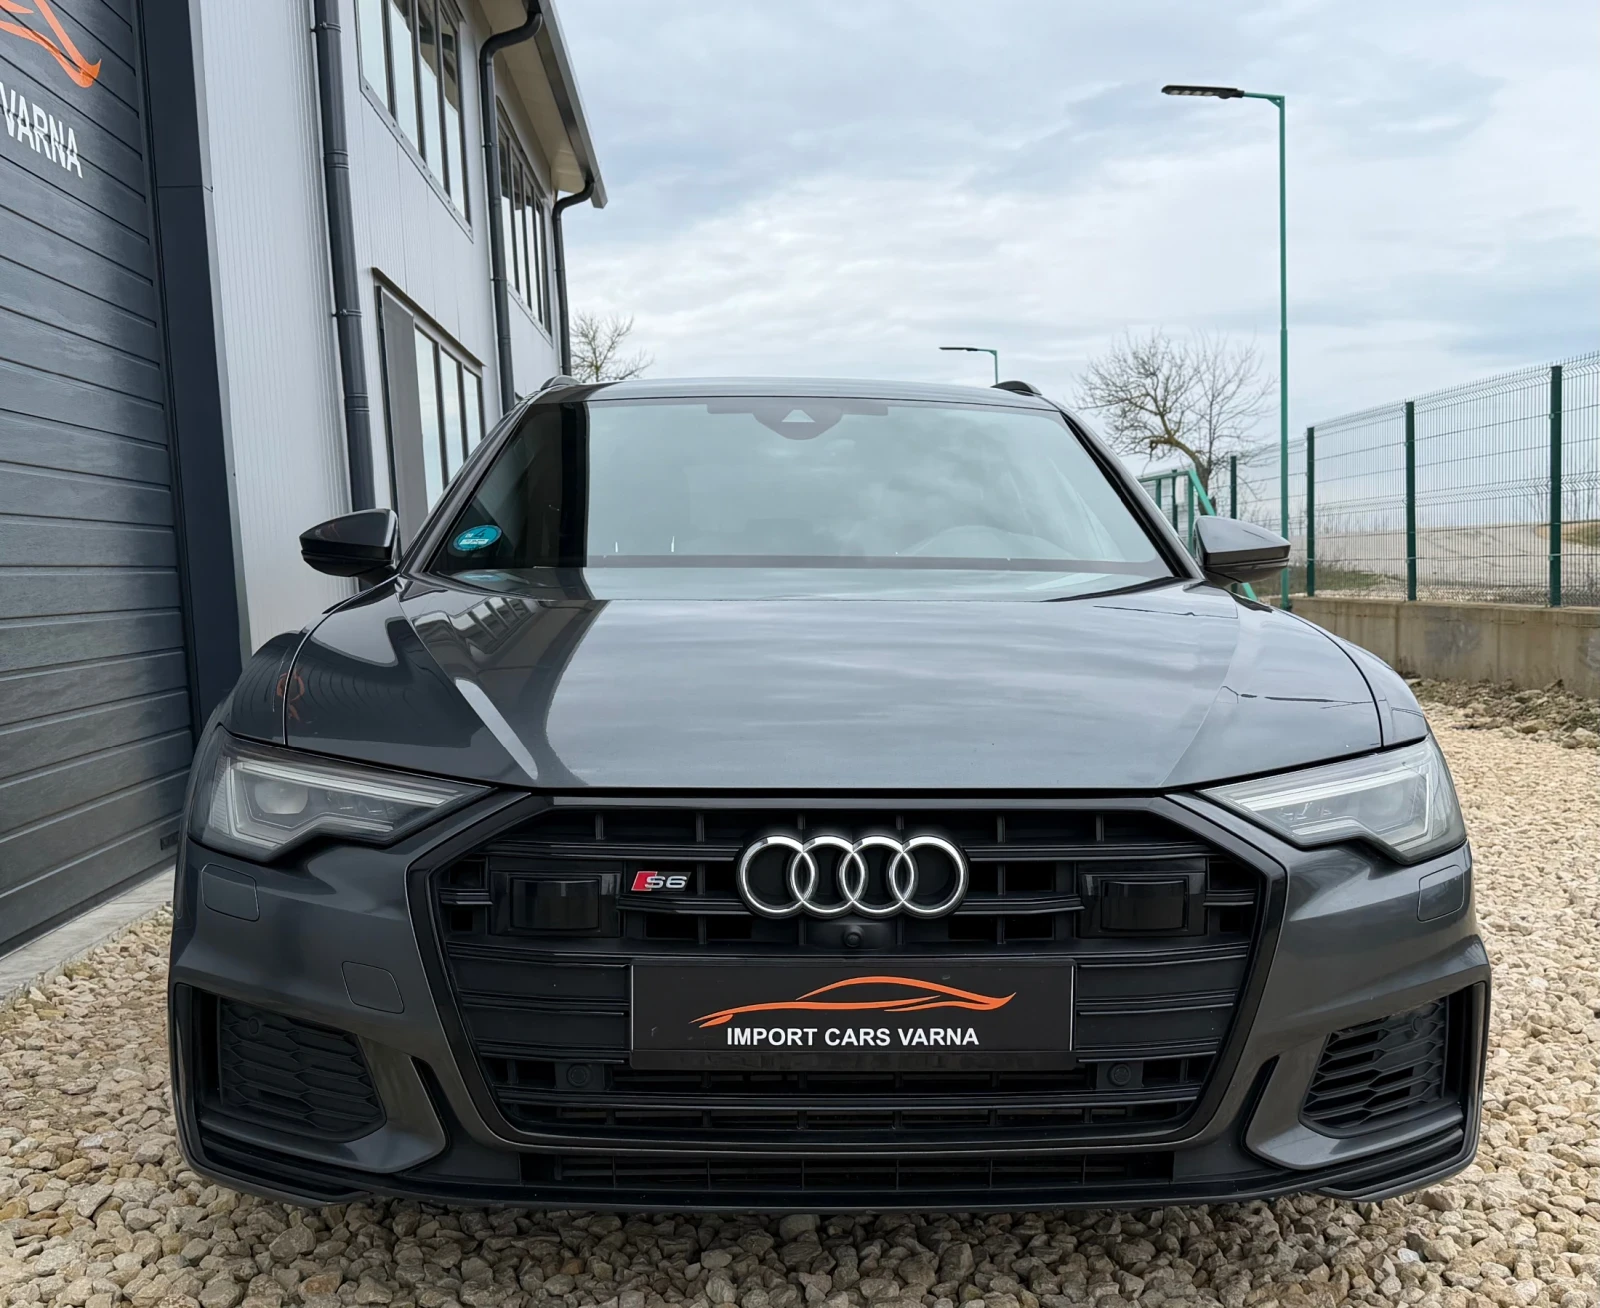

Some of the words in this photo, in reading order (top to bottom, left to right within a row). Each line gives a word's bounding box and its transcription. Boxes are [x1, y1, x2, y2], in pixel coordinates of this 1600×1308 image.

[0, 81, 83, 178] VARNA
[644, 875, 688, 889] S6
[727, 1027, 818, 1046] IMPORT
[824, 1027, 891, 1046] CARS
[898, 1027, 980, 1046] VARNA
